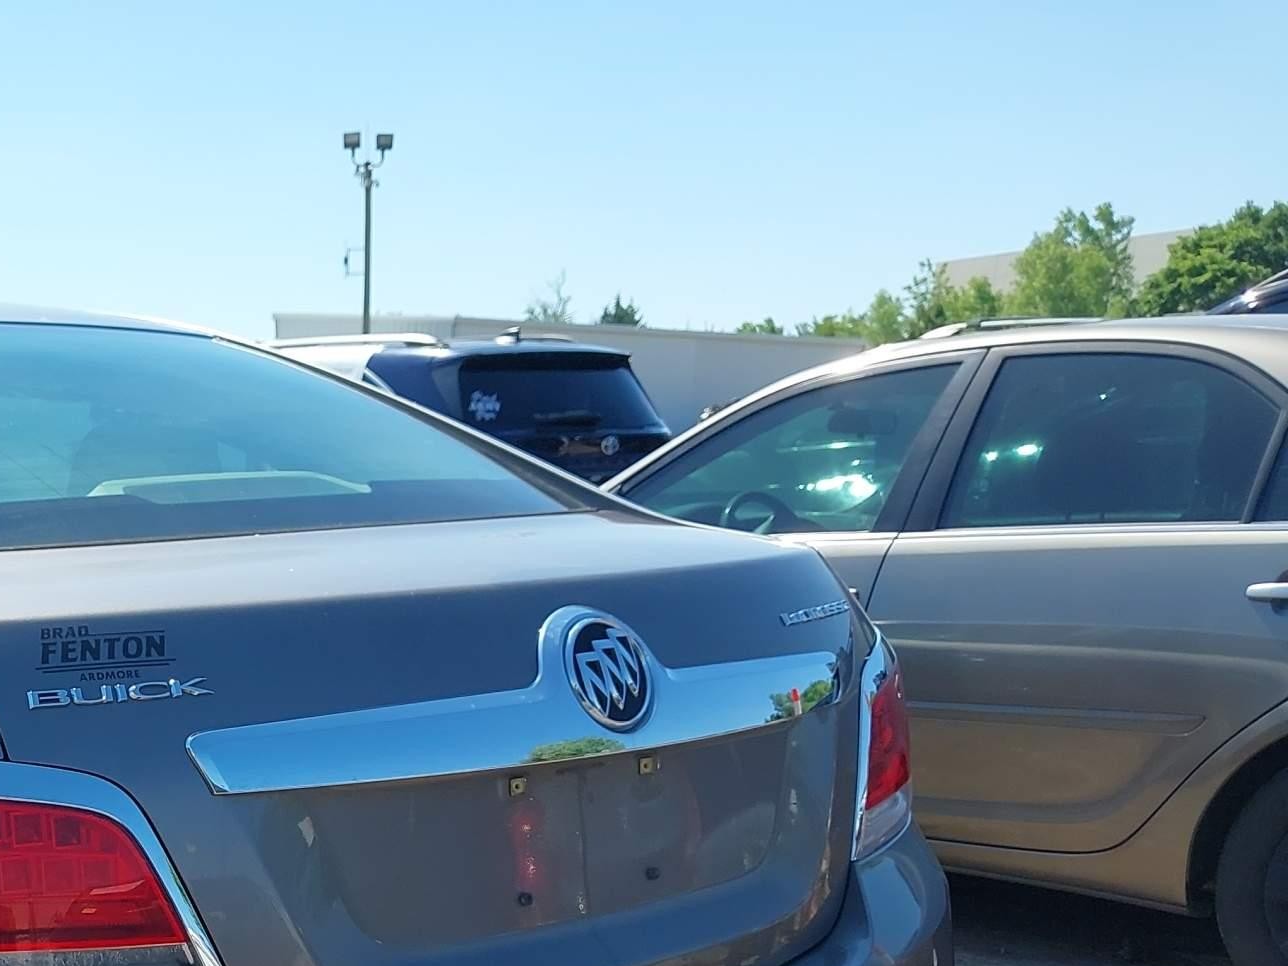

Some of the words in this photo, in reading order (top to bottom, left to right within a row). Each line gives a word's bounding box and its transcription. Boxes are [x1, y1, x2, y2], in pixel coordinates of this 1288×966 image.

[40, 625, 89, 640] BRAD
[40, 634, 166, 666] FENTON
[79, 669, 141, 682] ARDMORE
[26, 677, 216, 710] BUICK
